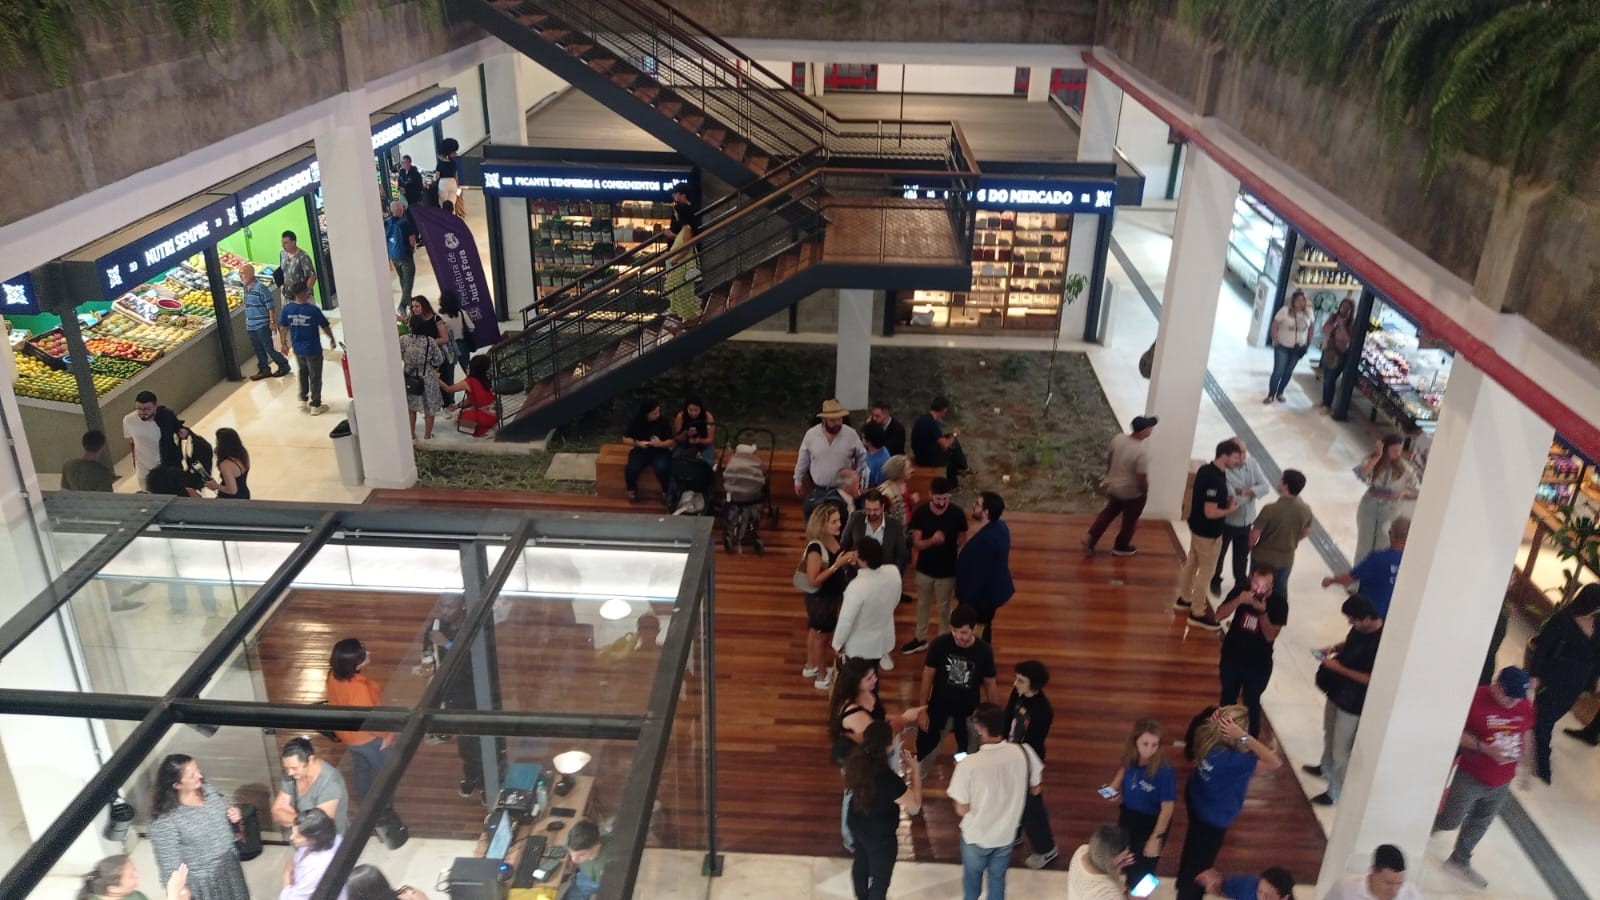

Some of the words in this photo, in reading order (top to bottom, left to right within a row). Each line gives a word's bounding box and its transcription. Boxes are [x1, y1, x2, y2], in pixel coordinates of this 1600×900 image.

[515, 176, 550, 187] PICANTE
[601, 179, 660, 191] CONDIMENTOS
[988, 188, 1009, 203] DO
[1010, 189, 1073, 205] MERCADO
[145, 238, 174, 266] NUTRI
[174, 221, 210, 250] SEMPRE
[447, 252, 457, 263] de
[459, 249, 471, 271] Fora
[452, 264, 470, 307] Prefeitura
[465, 271, 475, 282] de
[469, 283, 480, 302] Juiz
